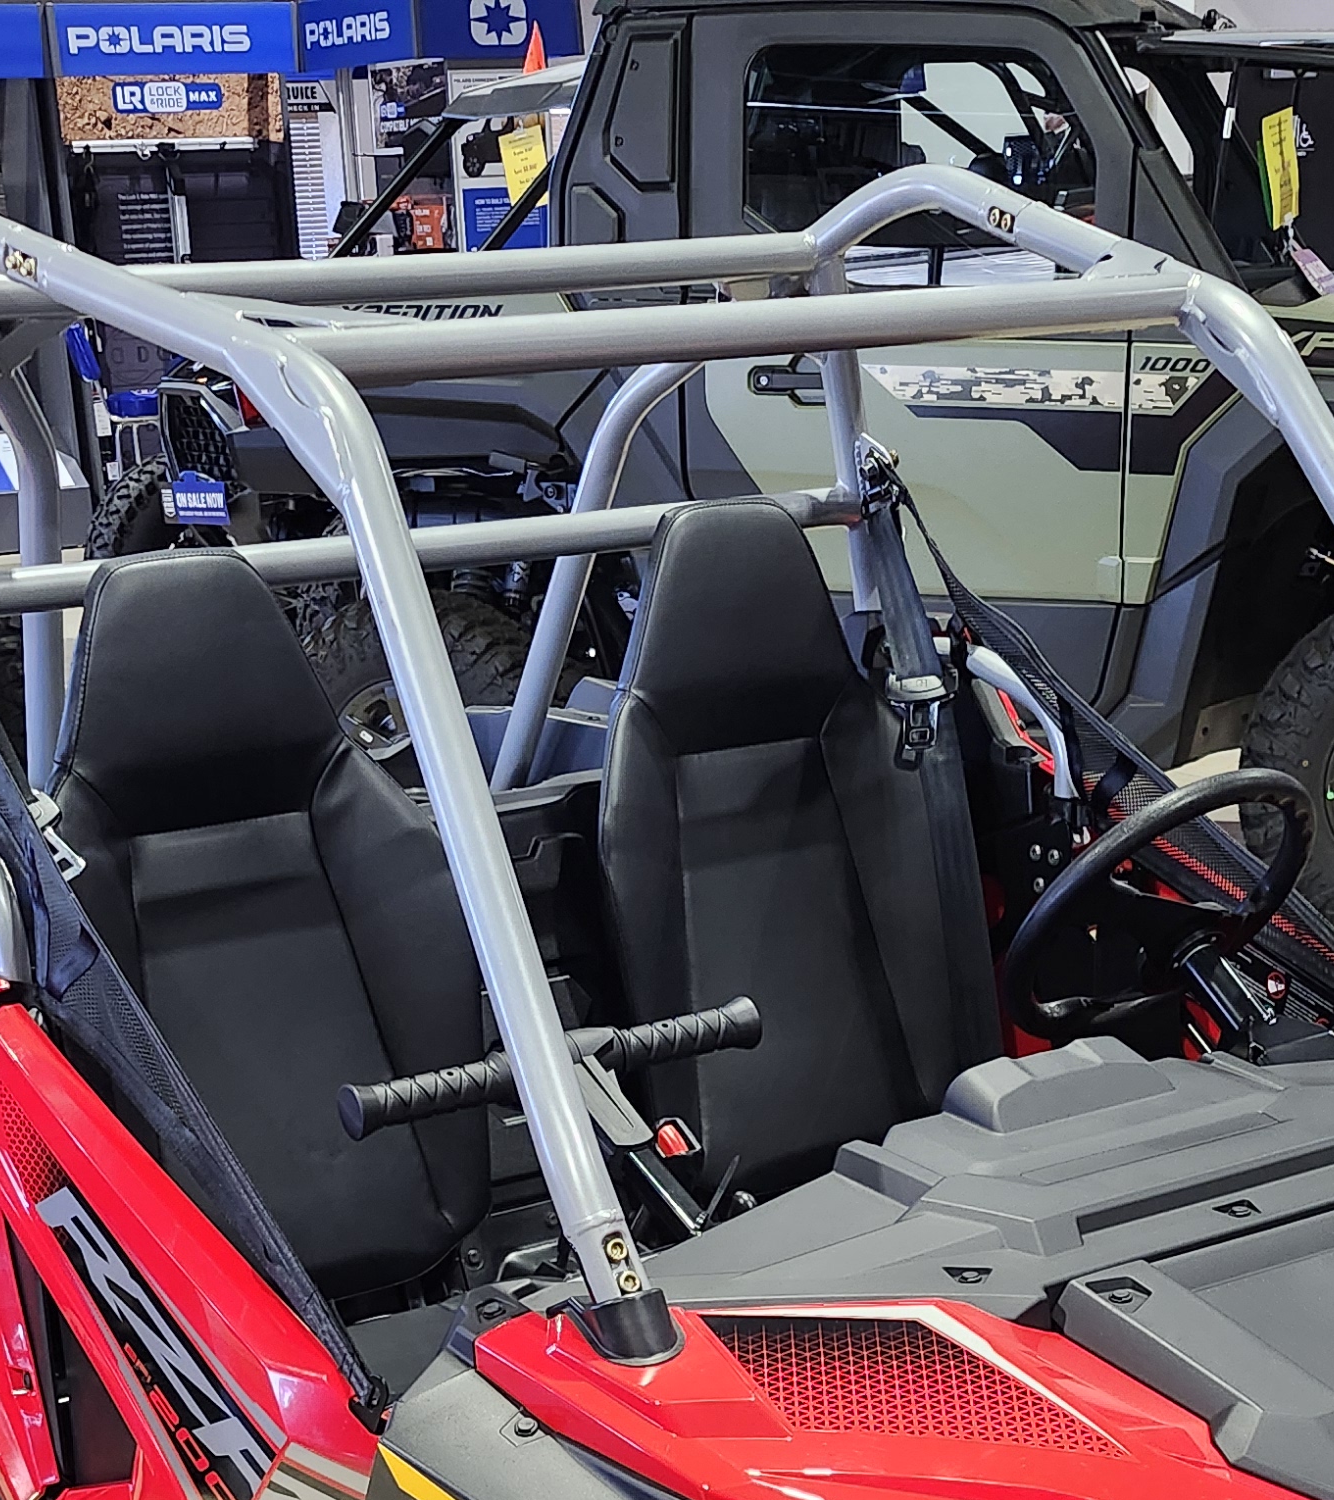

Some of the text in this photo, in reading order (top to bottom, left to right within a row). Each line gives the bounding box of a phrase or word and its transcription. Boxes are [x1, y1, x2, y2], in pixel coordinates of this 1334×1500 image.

[305, 11, 390, 49] POLARIS
[67, 25, 251, 55] POLARIS
[148, 86, 182, 97] LOCK
[188, 90, 218, 103] MAX
[1139, 356, 1211, 372] 1000
[176, 492, 187, 508] ON
[187, 492, 206, 508] SALE
[206, 492, 224, 508] NOW
